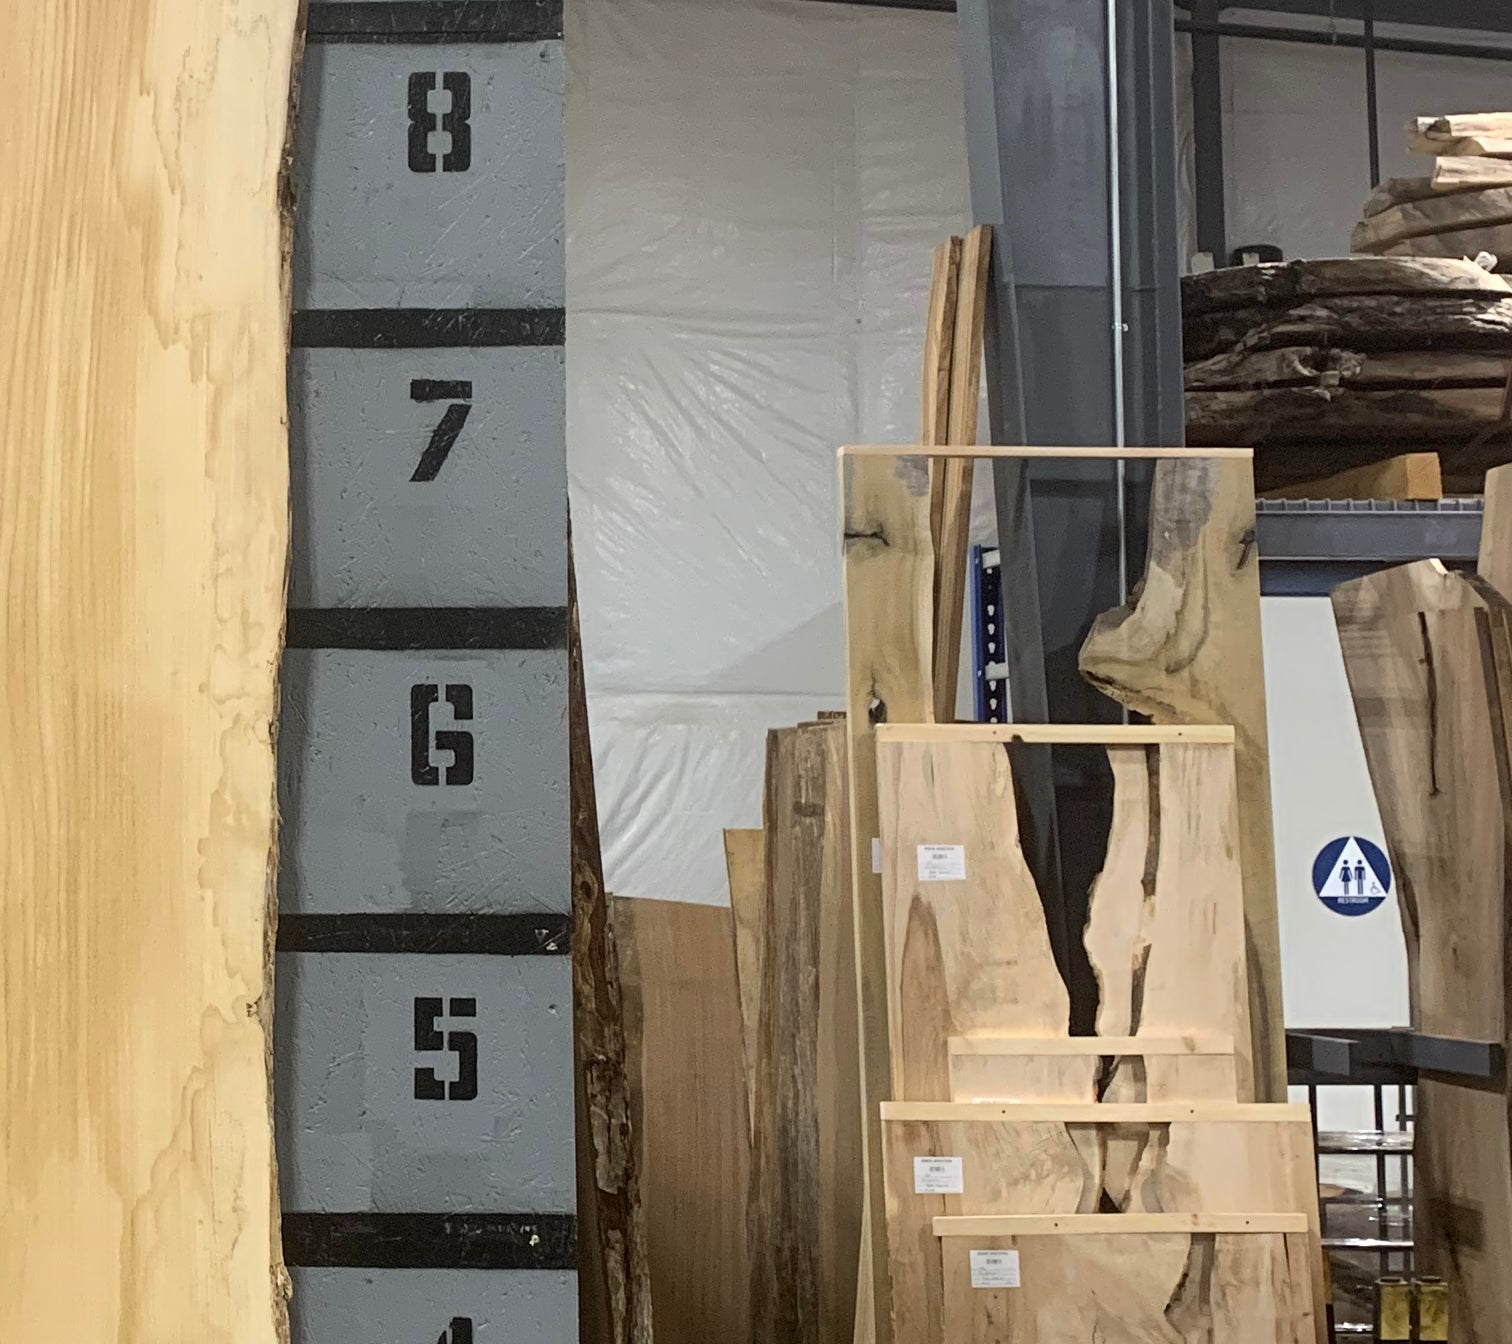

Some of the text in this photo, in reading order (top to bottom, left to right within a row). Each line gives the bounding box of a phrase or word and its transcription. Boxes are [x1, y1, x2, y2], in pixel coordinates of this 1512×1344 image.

[407, 71, 472, 174] 8
[408, 378, 473, 483] 7
[410, 683, 475, 787] 6
[413, 996, 479, 1101] 5
